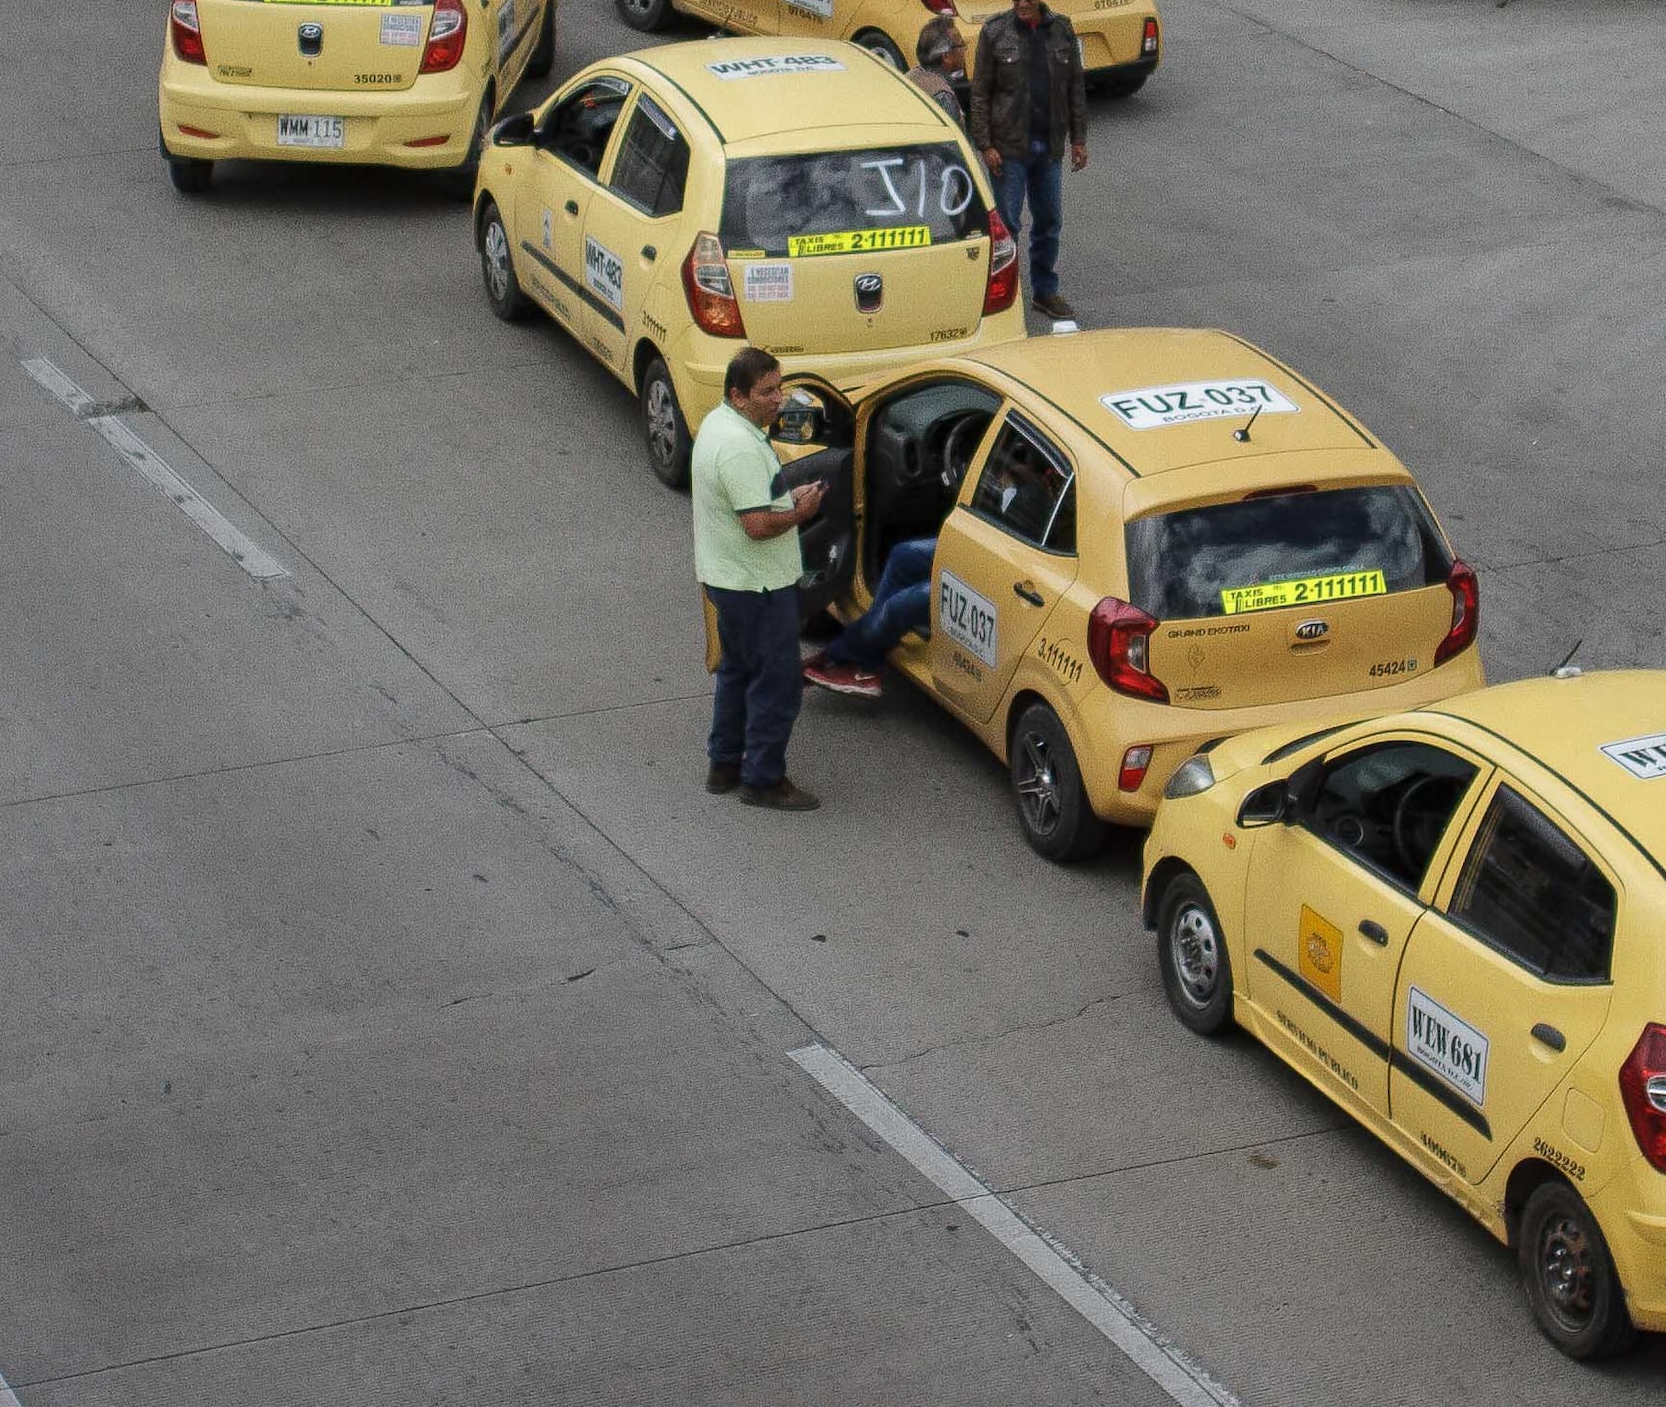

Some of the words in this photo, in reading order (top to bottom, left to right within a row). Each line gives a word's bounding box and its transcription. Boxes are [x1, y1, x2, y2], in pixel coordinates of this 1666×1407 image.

[710, 58, 779, 75] WHT
[782, 55, 837, 68] 483
[354, 74, 392, 84] 35020
[280, 118, 309, 136] WMM
[314, 119, 342, 139] 115
[795, 236, 825, 245] TAXIS
[806, 242, 845, 252] LIBRES
[1111, 391, 1204, 419] FUZ
[1203, 384, 1273, 406] 037
[1162, 408, 1232, 423] BOGOTA
[1231, 588, 1264, 600] TAXIS
[1244, 594, 1287, 609] LIBRES
[941, 582, 967, 630] FUZ
[970, 604, 995, 649] 037
[1167, 630, 1206, 640] GRAND
[1300, 624, 1326, 638] KIA
[1369, 660, 1407, 677] 45424
[1276, 1009, 1317, 1054] SERVICIO
[1318, 1044, 1359, 1091] PUBLICO
[1412, 1005, 1451, 1057] WEW
[1451, 1034, 1483, 1085] 681
